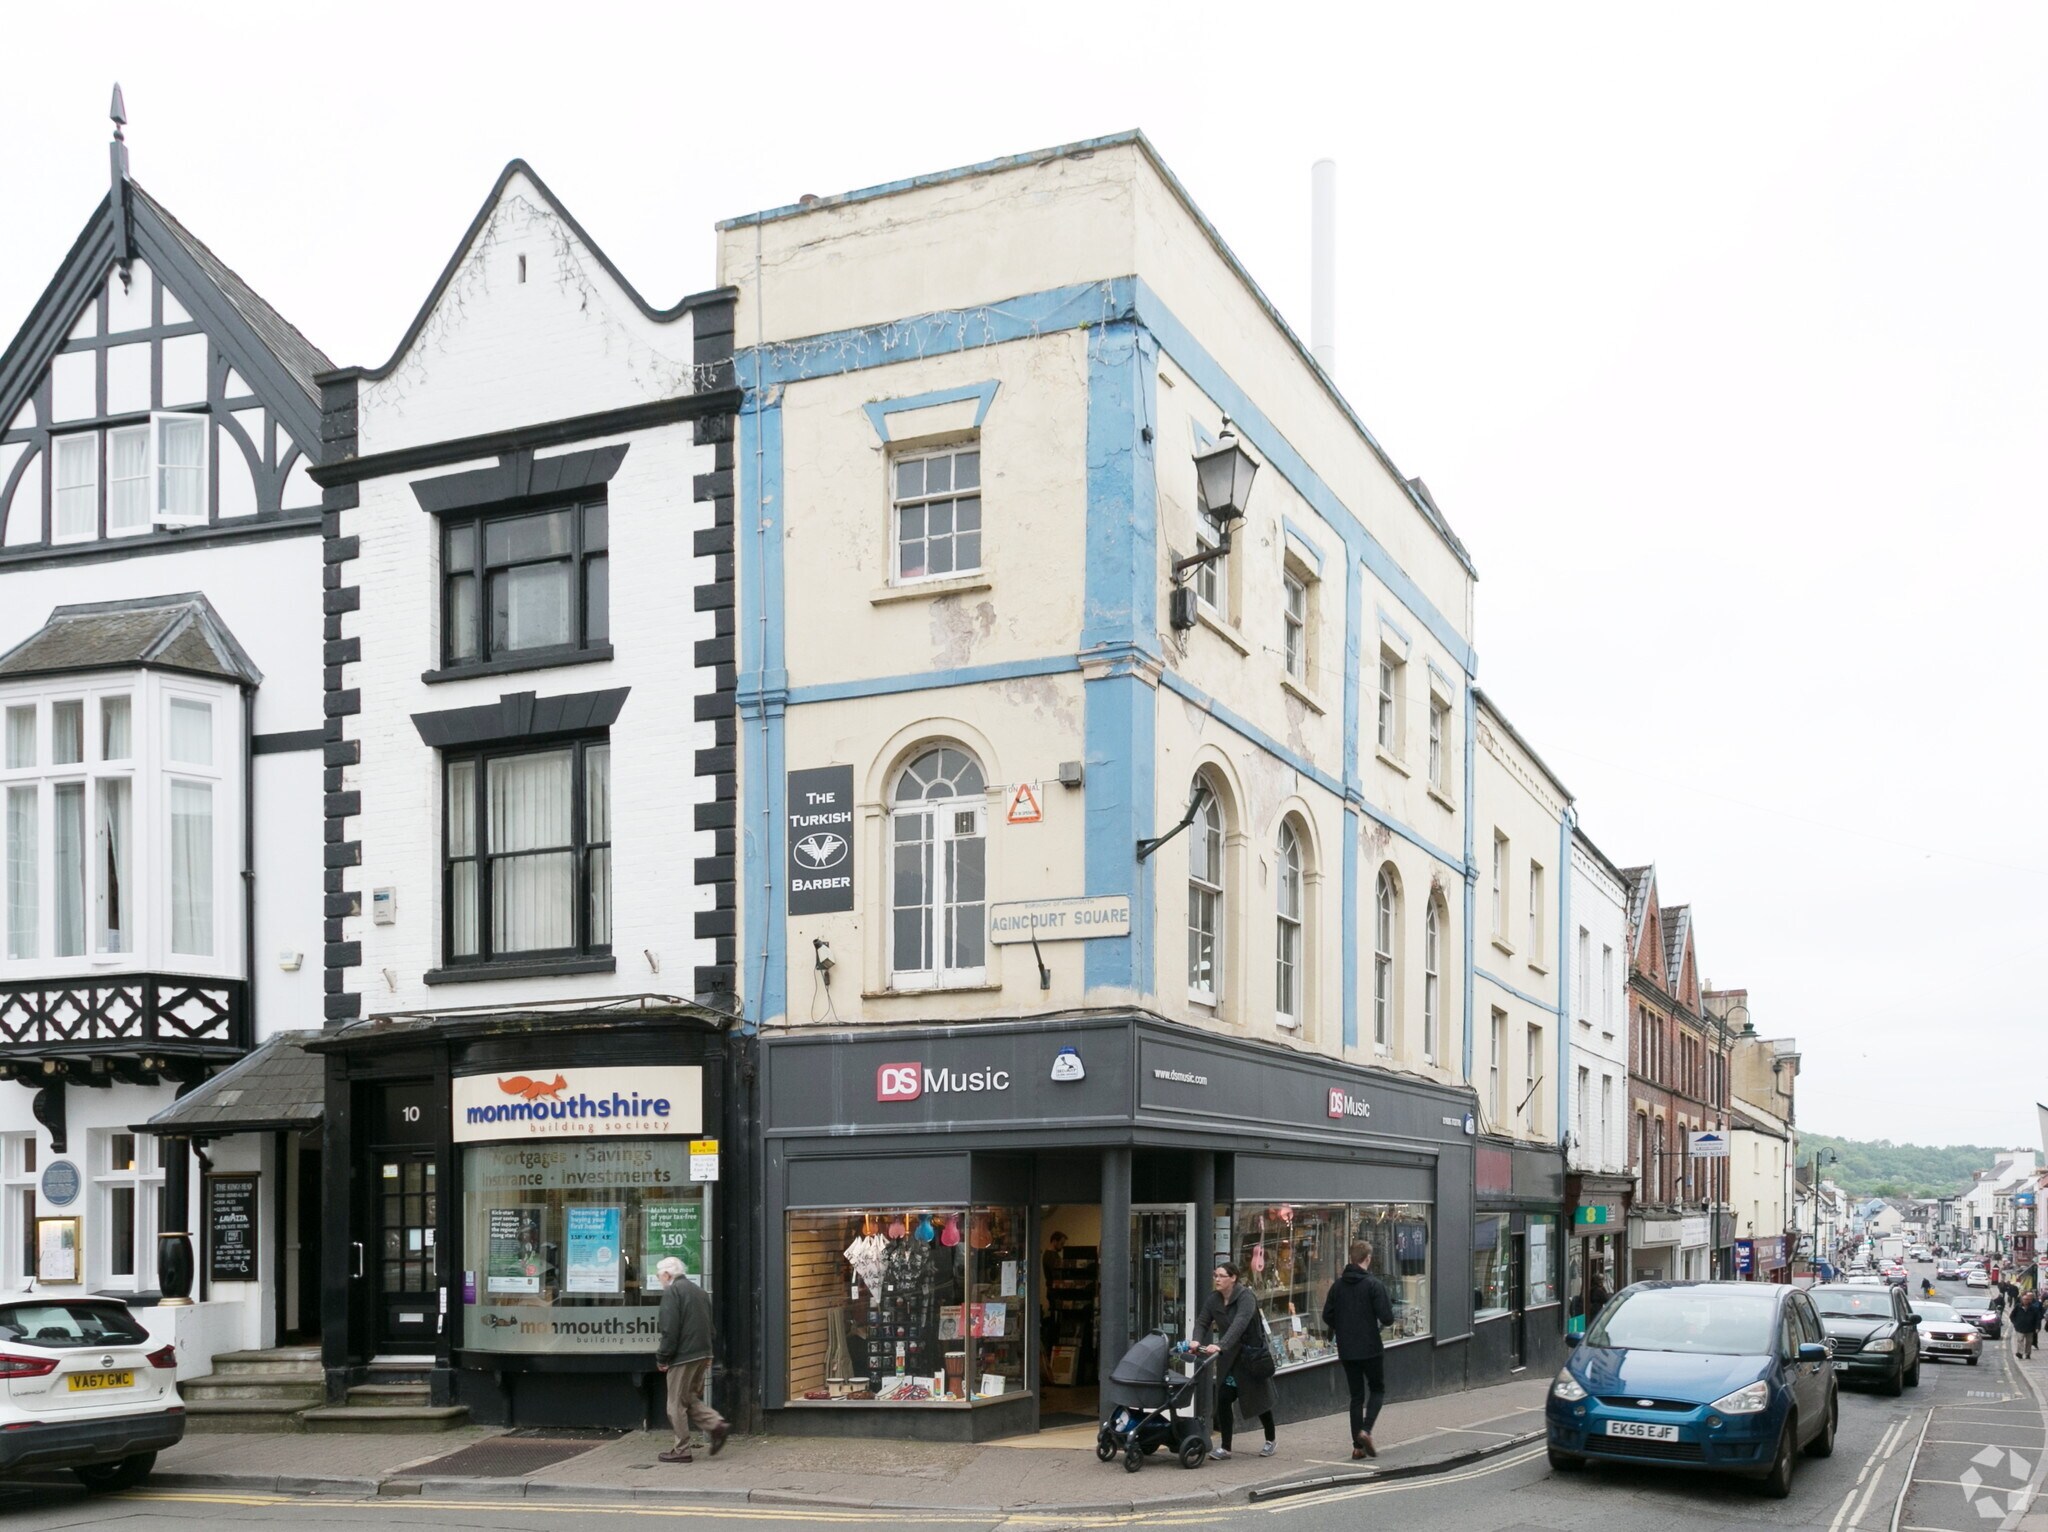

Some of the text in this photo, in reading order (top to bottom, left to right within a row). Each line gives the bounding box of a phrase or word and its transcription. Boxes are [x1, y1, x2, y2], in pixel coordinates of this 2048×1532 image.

[991, 908, 1129, 932] AGINCOURT SQUARE
[881, 1066, 1010, 1095] DS Music
[1154, 1069, 1208, 1086] www.dsmusic.com
[467, 1092, 671, 1124] monmouthshire
[1330, 1091, 1371, 1118] DS Music
[402, 1106, 420, 1122] 10
[530, 1120, 669, 1133] building society
[492, 1146, 653, 1169] Mortgages Savings
[576, 1336, 624, 1345] building
[73, 1374, 105, 1388] VA67
[1611, 1422, 1673, 1438] EK56 EJF
